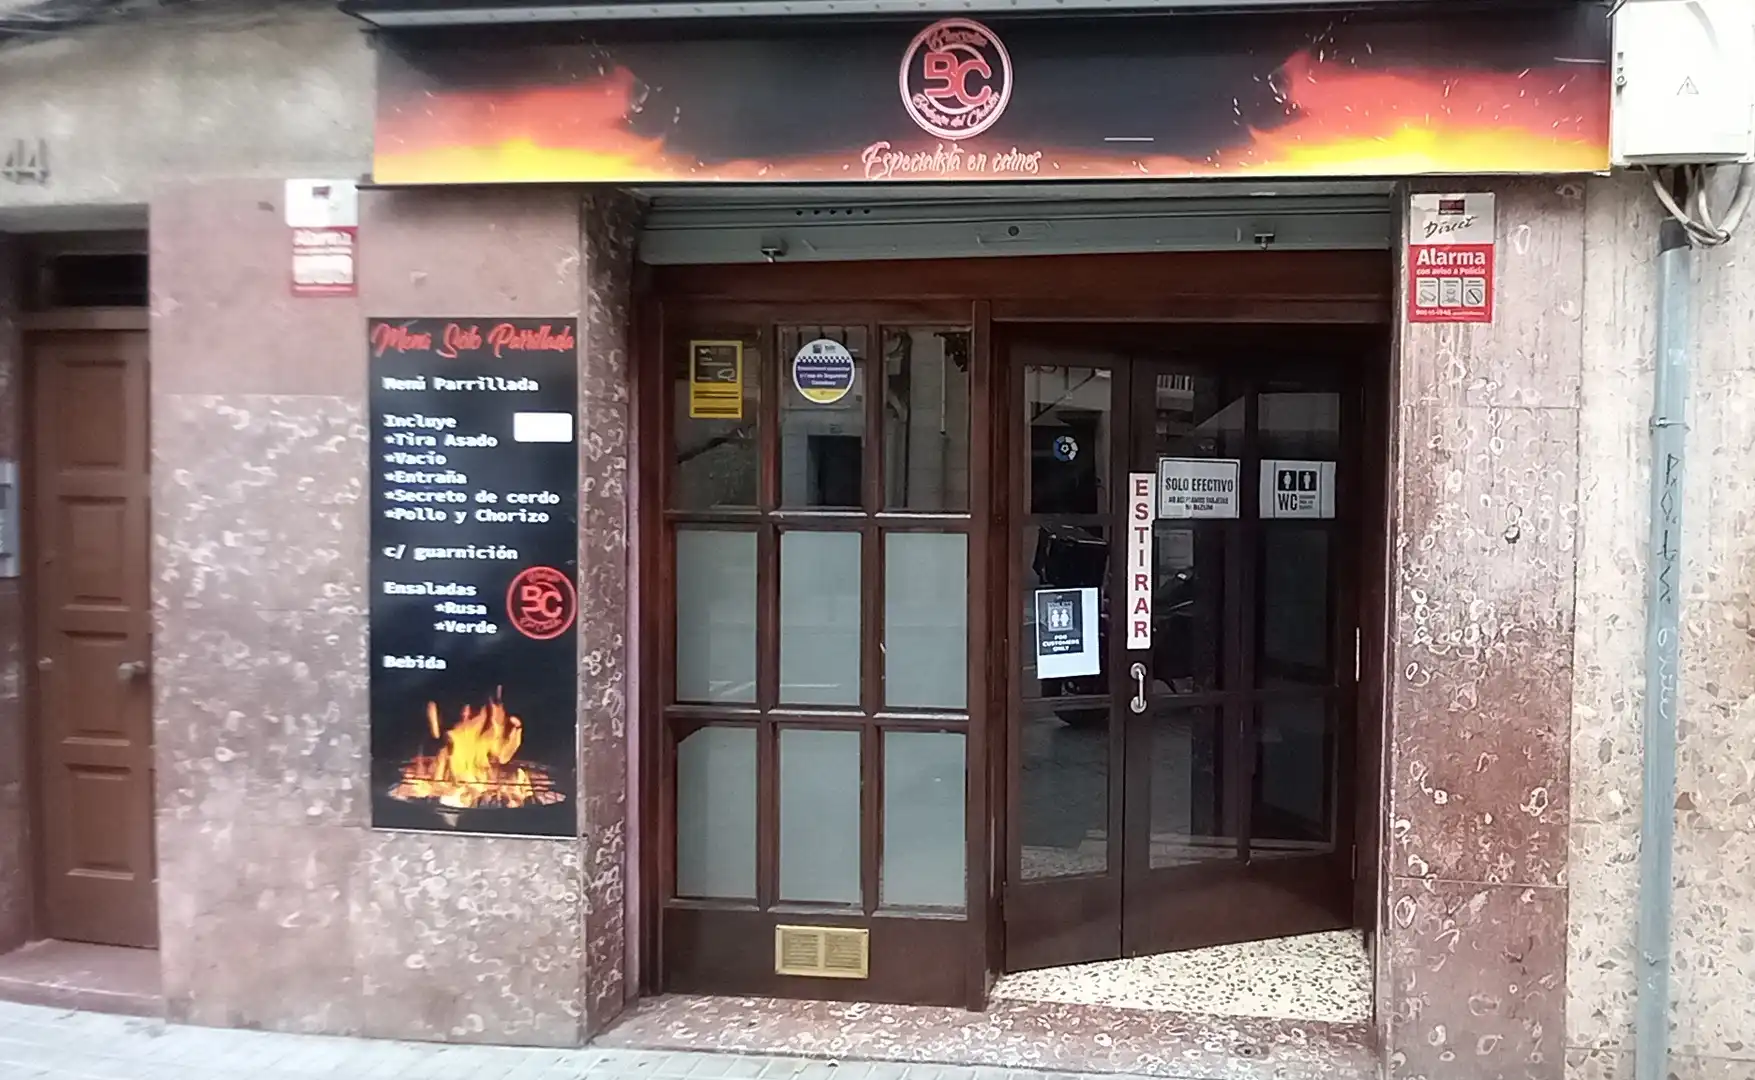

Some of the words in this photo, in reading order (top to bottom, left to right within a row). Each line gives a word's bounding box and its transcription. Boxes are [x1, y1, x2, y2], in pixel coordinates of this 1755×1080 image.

[861, 141, 965, 180] Especialista
[967, 152, 988, 172] en
[1416, 247, 1486, 266] Alarma
[432, 376, 539, 391] Parrillada
[382, 413, 458, 431] Incluye
[443, 433, 499, 448] Asado
[1165, 477, 1189, 492] SOLO
[1191, 477, 1234, 493] EFECTIVO
[474, 489, 499, 504] de
[506, 490, 561, 505] cerdo
[1278, 493, 1298, 511] WC
[453, 510, 468, 525] y
[474, 508, 550, 524] Chorizo
[382, 543, 407, 560] c/
[413, 544, 519, 561] guarnición
[1133, 479, 1150, 638] ESTIRAR
[383, 581, 477, 597] Ensaladas
[382, 655, 447, 670] Bebida
